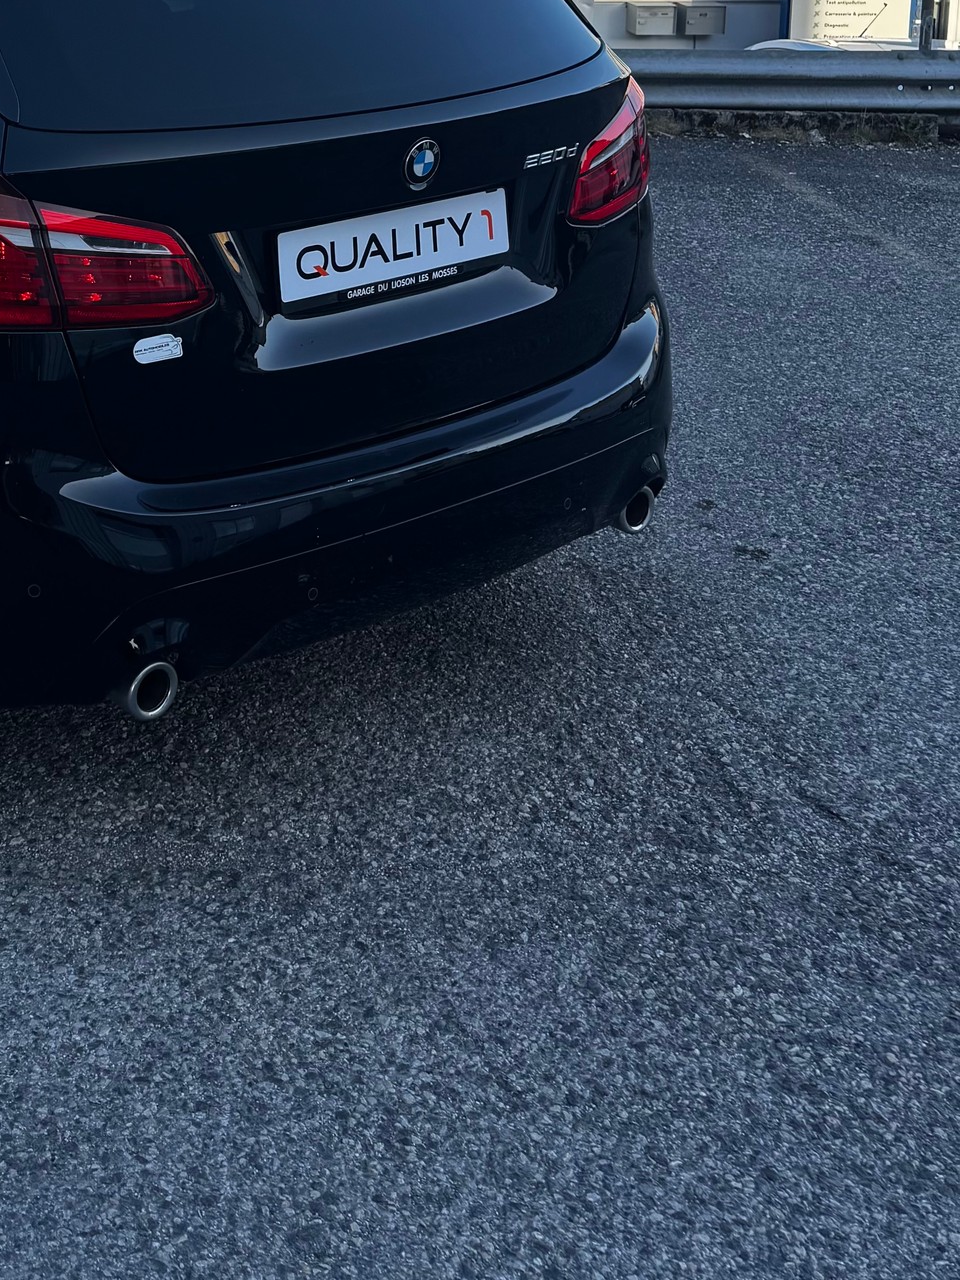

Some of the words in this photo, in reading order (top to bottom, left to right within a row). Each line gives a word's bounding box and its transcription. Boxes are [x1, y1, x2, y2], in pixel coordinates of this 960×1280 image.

[523, 142, 580, 169] 220d
[296, 212, 472, 280] QUALITY
[480, 209, 494, 240] 1
[347, 285, 375, 299] GARAGE
[377, 282, 389, 292] DU
[418, 273, 429, 283] LES
[432, 266, 458, 279] MOSSES
